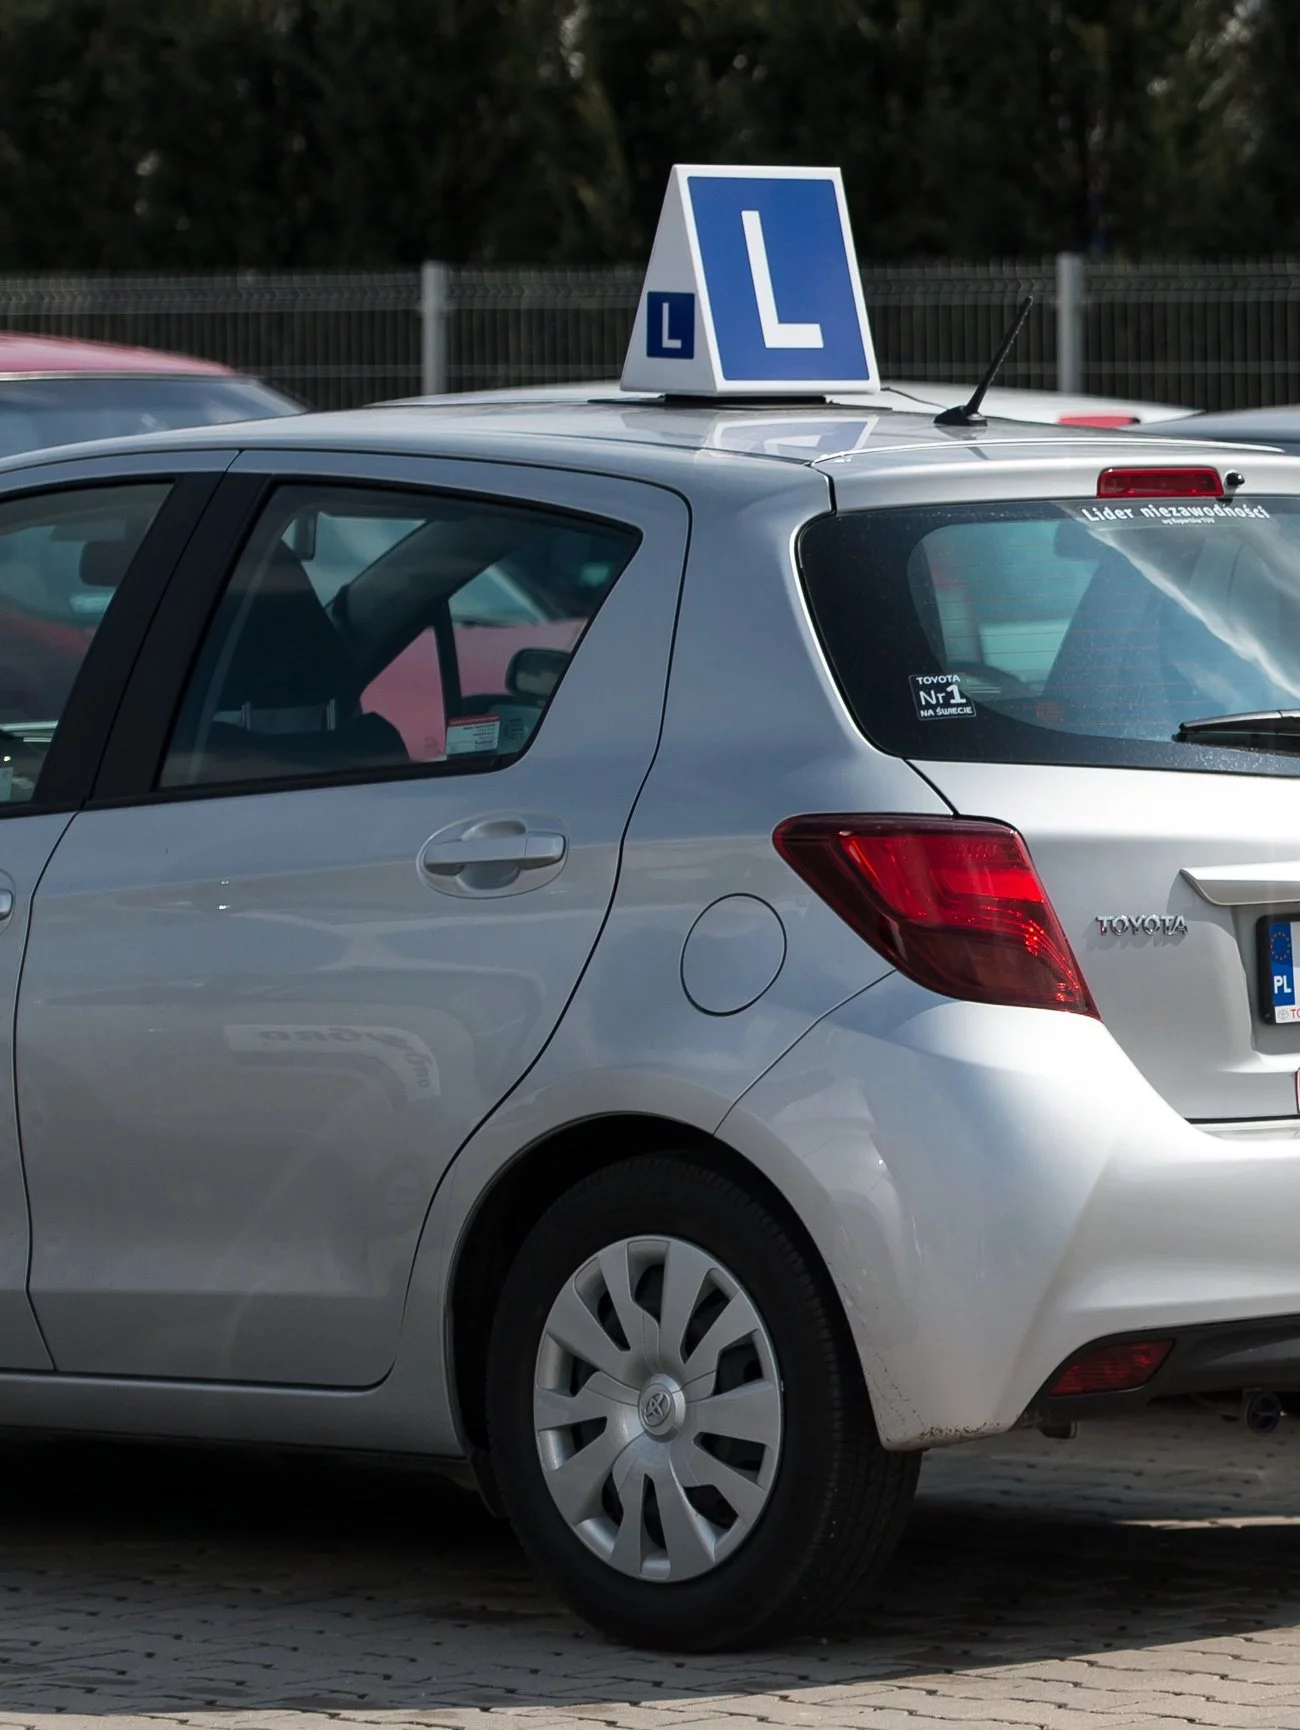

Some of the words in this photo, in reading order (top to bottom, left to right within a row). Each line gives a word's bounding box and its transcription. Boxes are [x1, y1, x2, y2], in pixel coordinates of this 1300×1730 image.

[741, 210, 824, 349] L
[661, 302, 682, 349] L
[1081, 506, 1134, 522] Lider
[1140, 504, 1270, 519] niezawodności
[915, 674, 961, 685] TOYOTA
[920, 709, 935, 717] NA
[936, 706, 973, 716] ŚWIECIE
[1094, 914, 1188, 936] TOYOTA
[1273, 975, 1291, 994] PL
